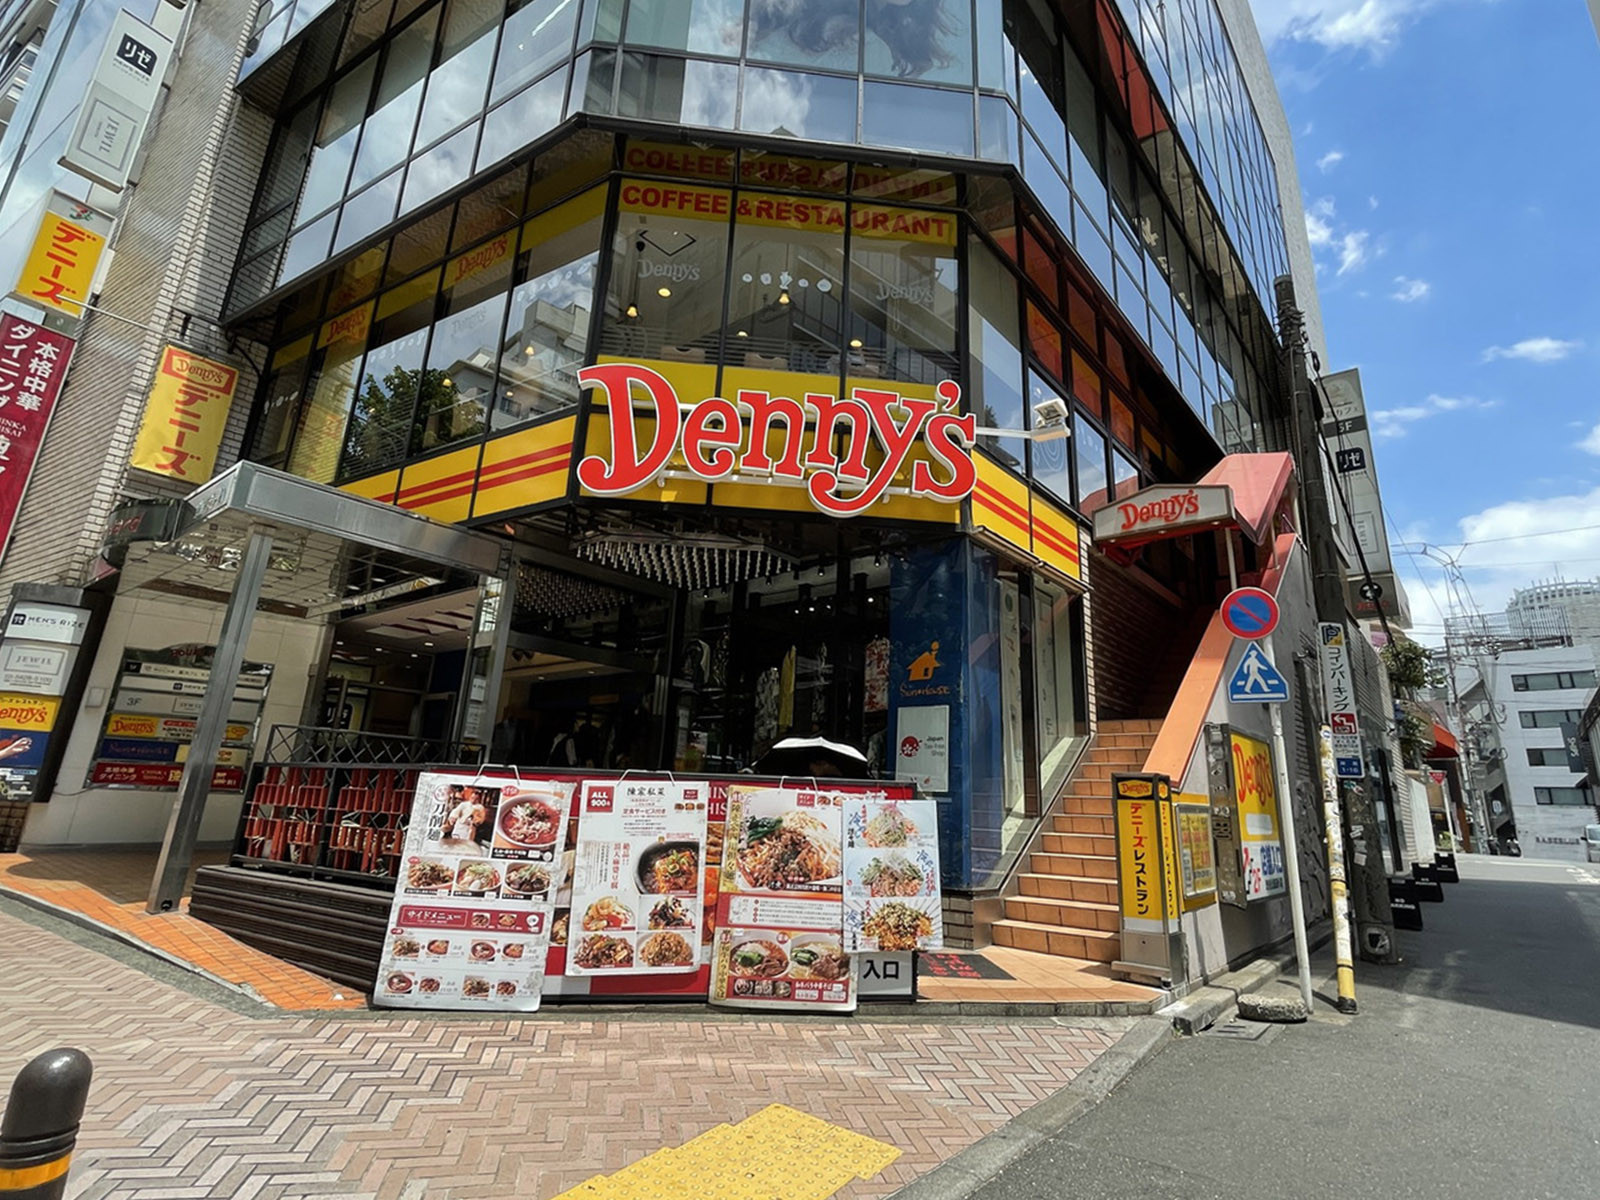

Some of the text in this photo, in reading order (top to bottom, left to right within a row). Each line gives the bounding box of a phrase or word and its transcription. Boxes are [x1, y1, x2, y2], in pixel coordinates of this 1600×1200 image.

[124, 41, 152, 70] リゼ
[622, 185, 728, 215] COFFEE
[755, 199, 950, 238] RESTAURANT
[32, 221, 98, 305] デニーズ
[637, 259, 701, 282] Denny's
[15, 341, 60, 411] 本格中華
[176, 358, 223, 384] Denny's
[155, 383, 220, 476] デニーズ
[577, 362, 978, 519] Denny's
[1117, 489, 1200, 530] Denny's
[1328, 646, 1350, 712] コインパーキング
[0, 706, 48, 724] enny's
[1130, 803, 1150, 916] デニーズレストラン
[407, 910, 462, 921] サイドメニュー
[863, 959, 900, 981] 入口
